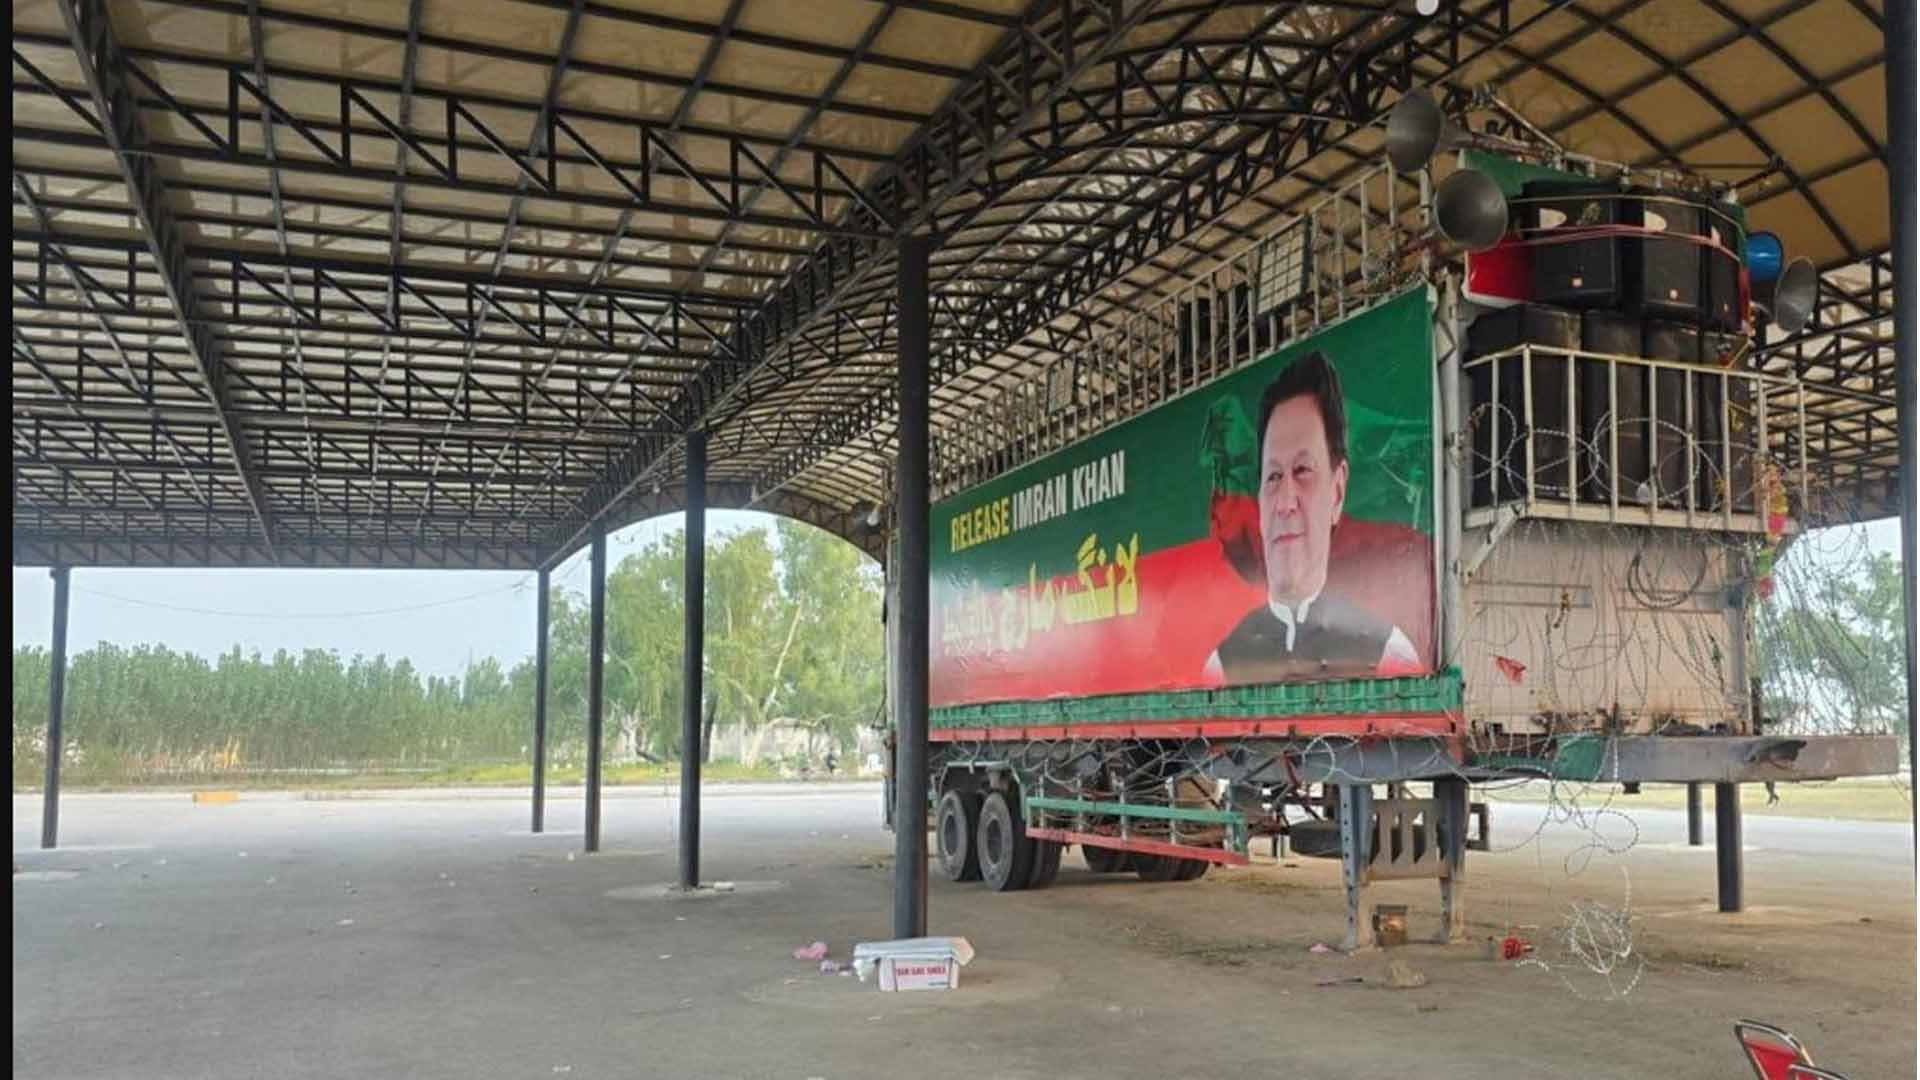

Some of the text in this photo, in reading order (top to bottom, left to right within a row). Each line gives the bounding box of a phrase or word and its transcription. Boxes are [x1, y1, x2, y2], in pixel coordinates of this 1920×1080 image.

[951, 450, 1126, 552] RELEASE IMRAN KHAN
[1062, 533, 1138, 625] لانگ
